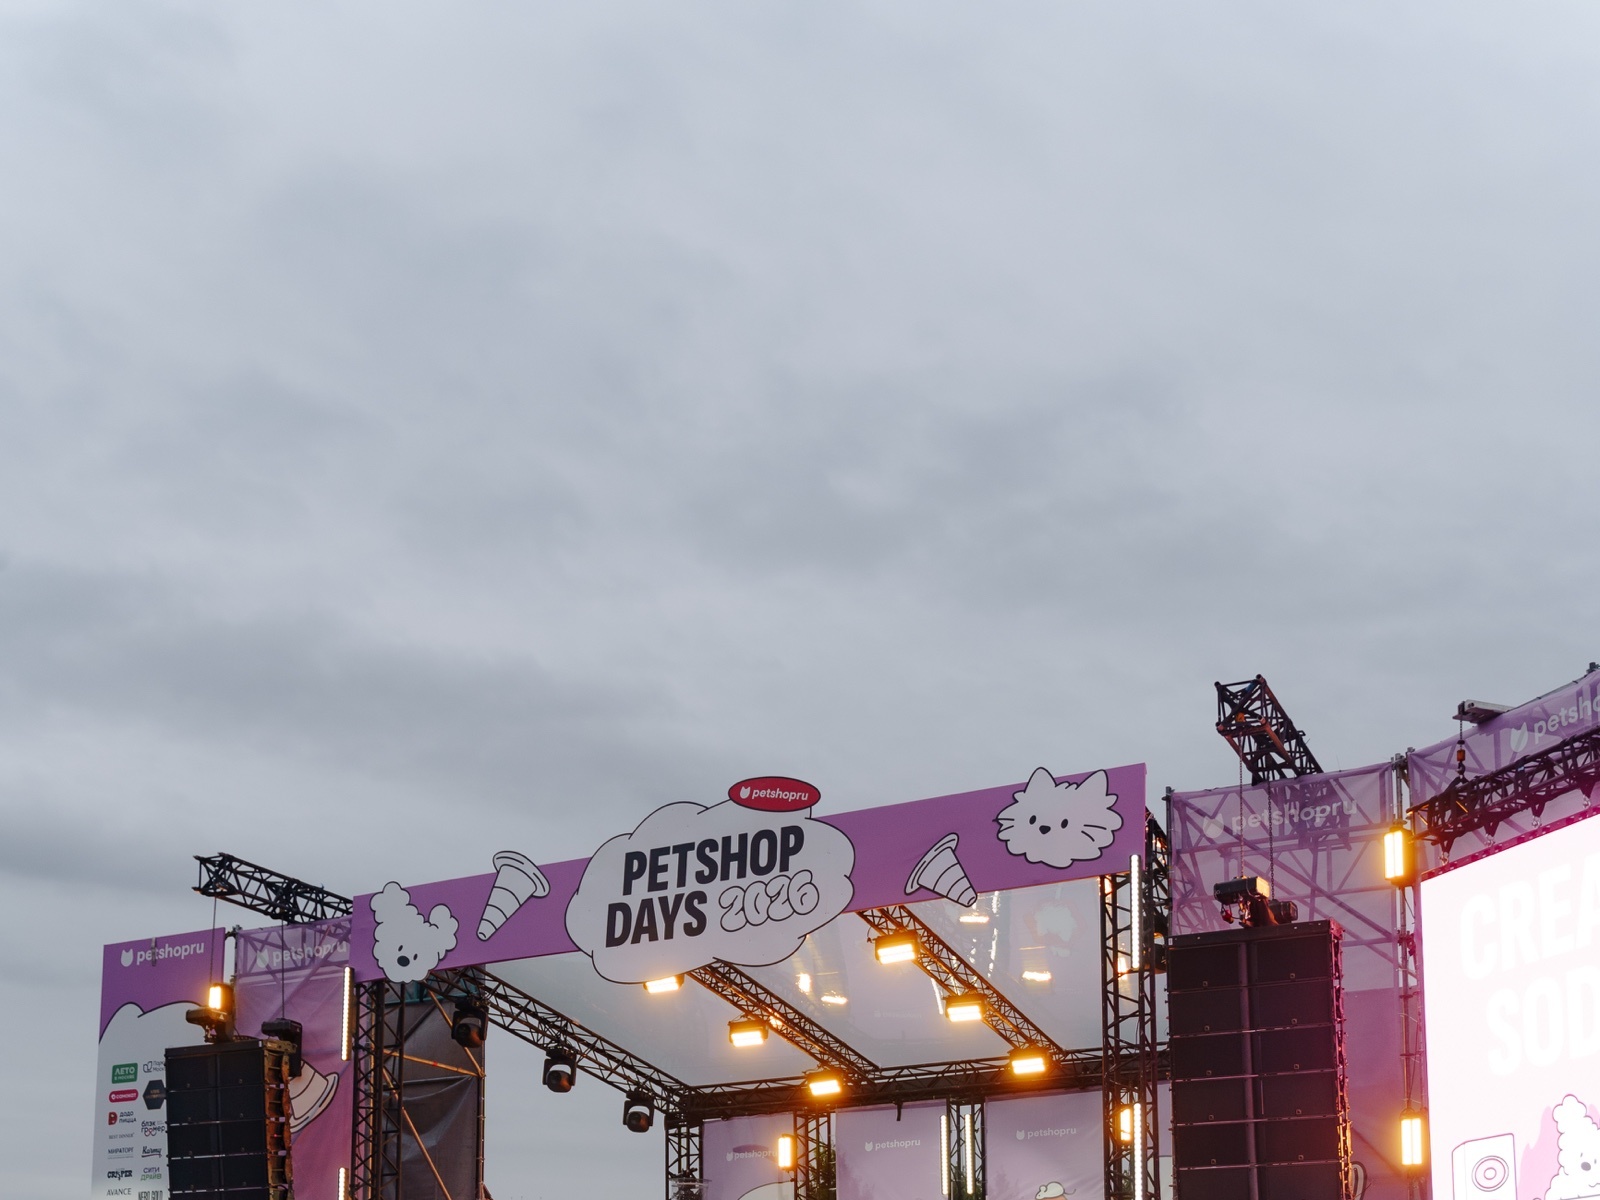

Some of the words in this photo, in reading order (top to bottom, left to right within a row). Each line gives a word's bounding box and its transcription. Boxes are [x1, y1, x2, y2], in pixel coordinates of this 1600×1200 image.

[752, 788, 808, 802] petshopru
[1232, 801, 1357, 835] petshopru
[623, 825, 804, 895] PETSHOP
[605, 890, 707, 948] DAYS
[719, 869, 819, 932] 2026
[272, 941, 347, 966] petshopru
[114, 1066, 136, 1075] ЛЕТО
[1027, 1127, 1077, 1140] petshopru
[875, 1139, 921, 1151] petshopru
[107, 1188, 132, 1196] AVANCE
